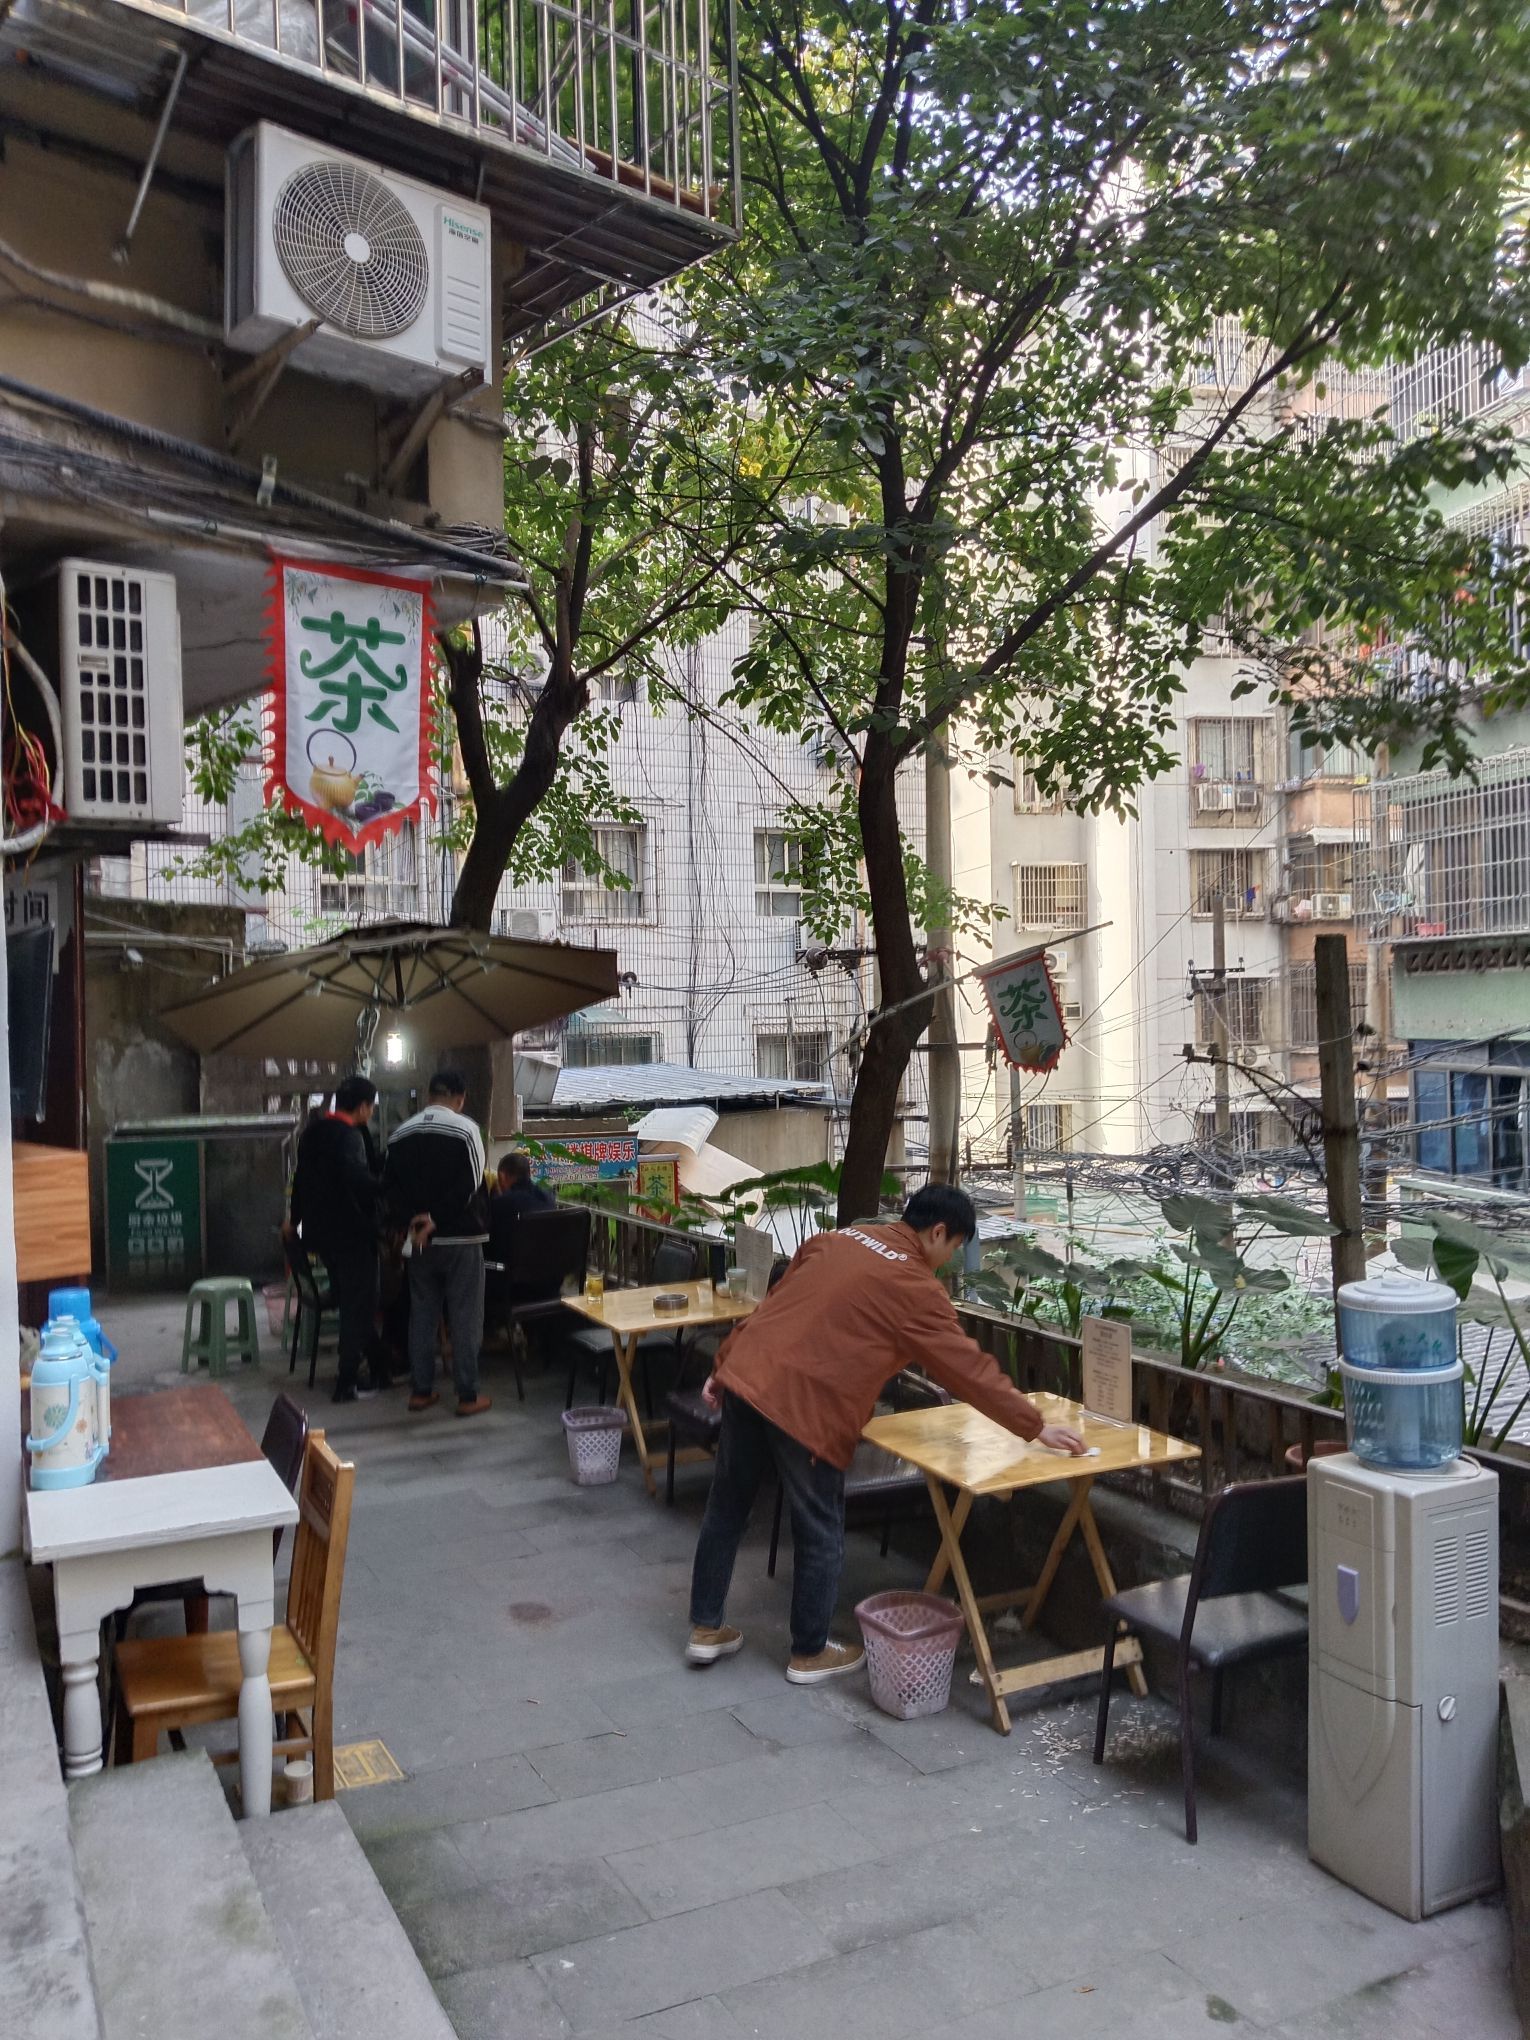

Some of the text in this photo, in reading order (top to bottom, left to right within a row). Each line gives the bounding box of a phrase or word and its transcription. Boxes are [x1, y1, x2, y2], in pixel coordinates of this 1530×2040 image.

[443, 216, 484, 239] Hisense
[300, 610, 408, 734] 茶
[997, 978, 1049, 1034] 茶
[646, 1174, 668, 1198] 茶
